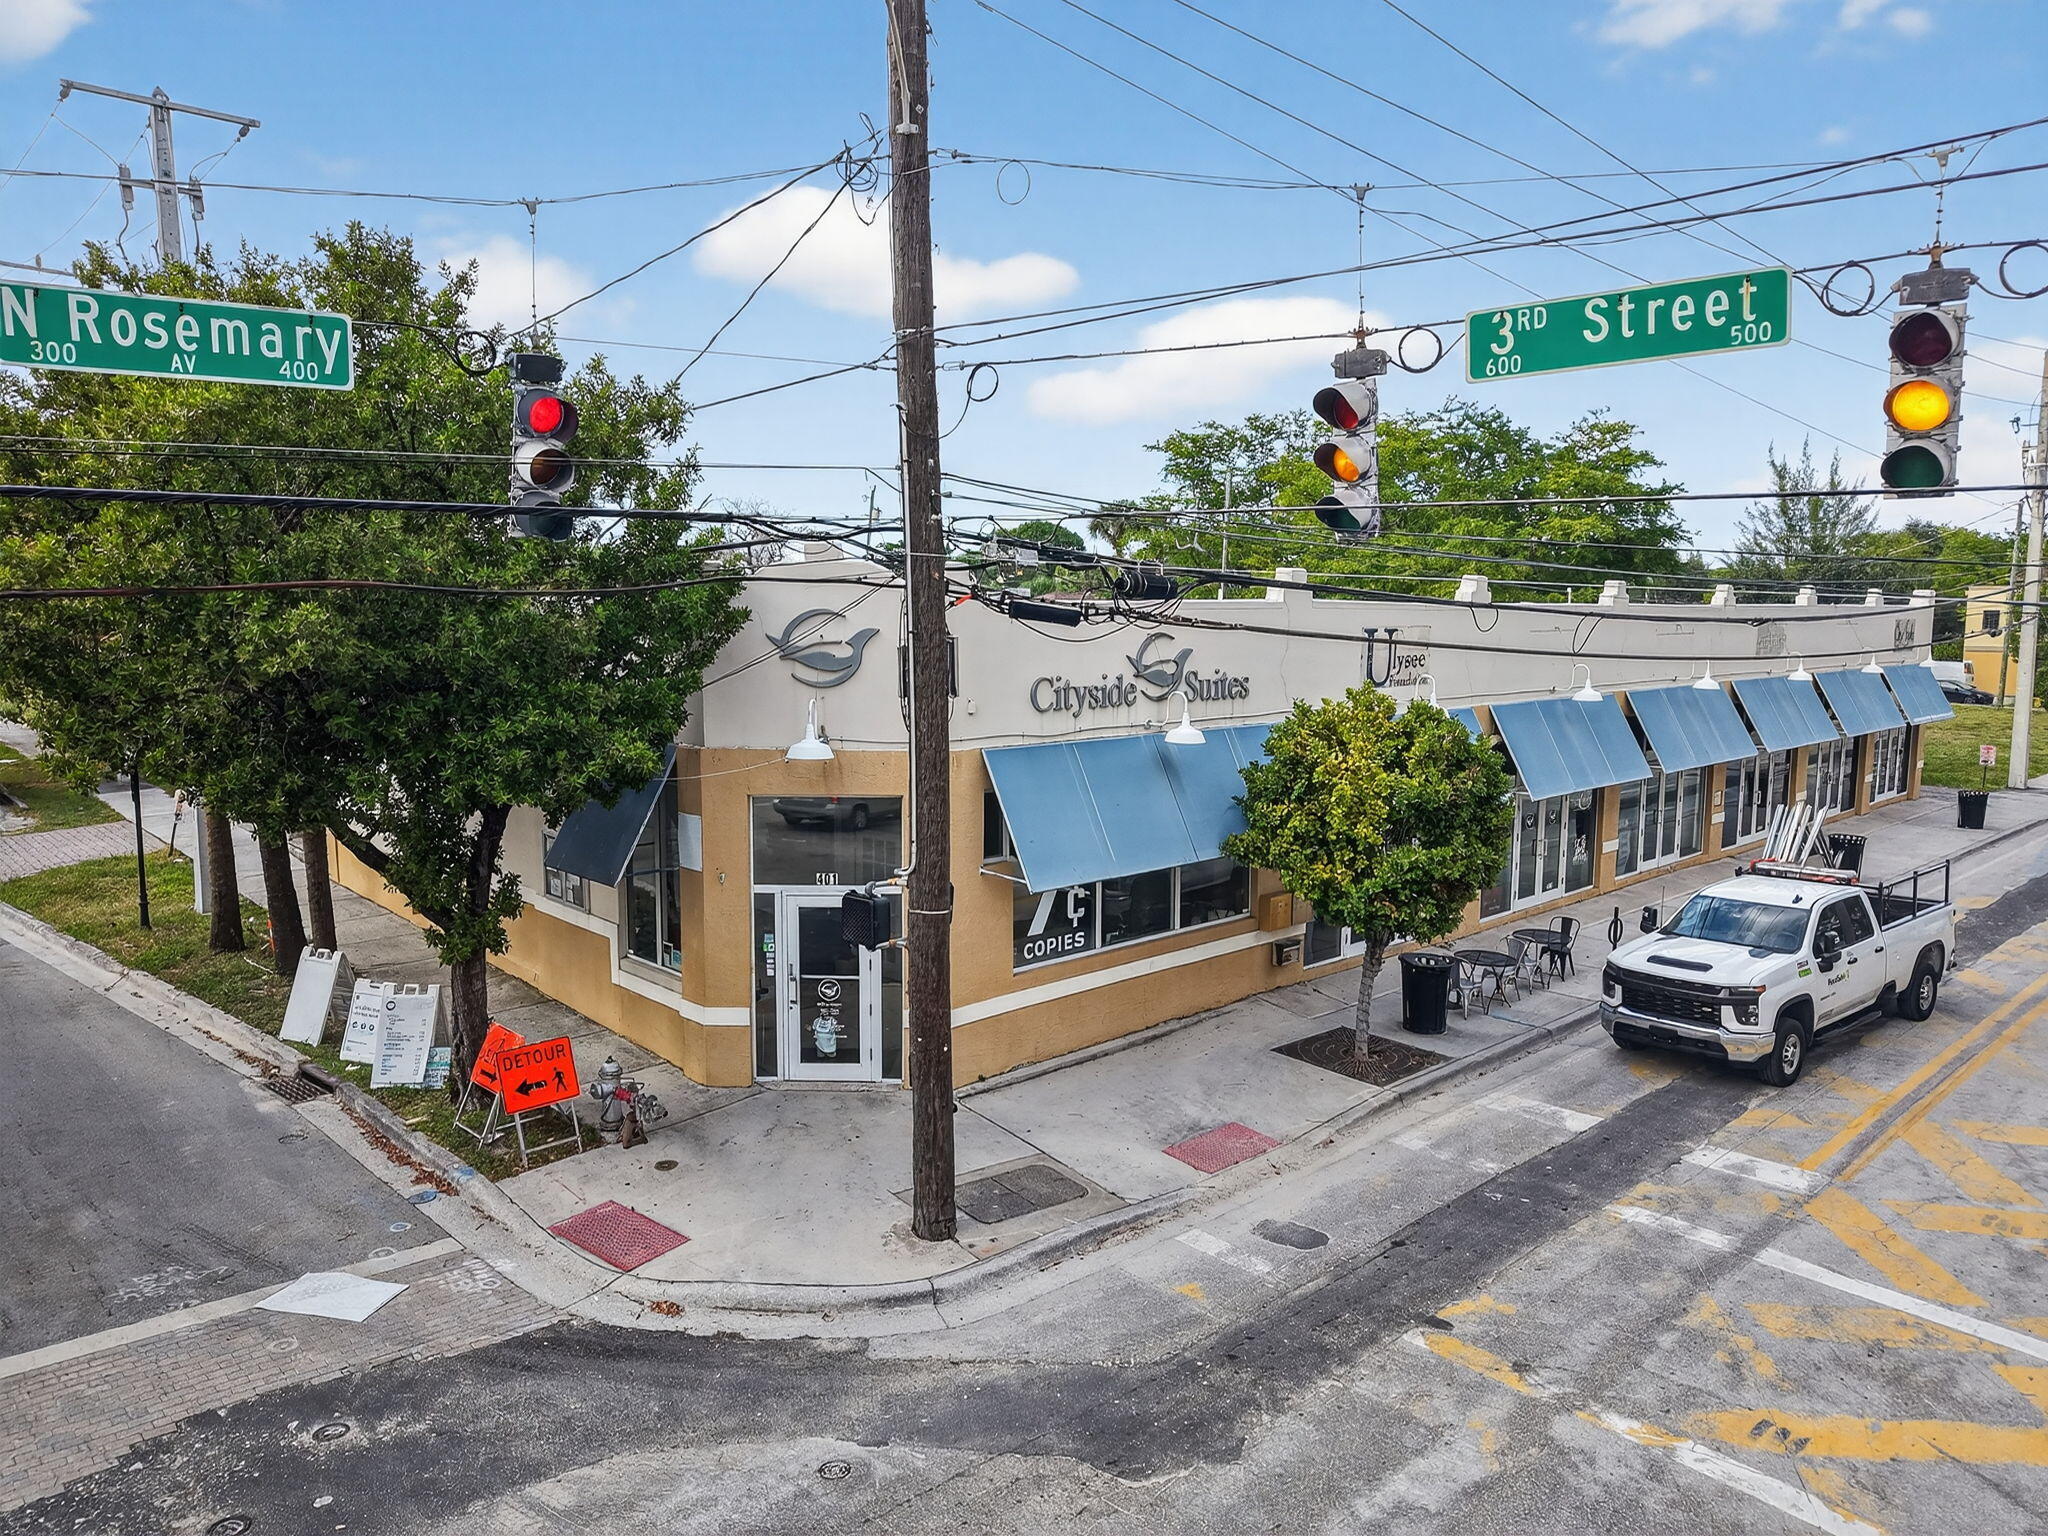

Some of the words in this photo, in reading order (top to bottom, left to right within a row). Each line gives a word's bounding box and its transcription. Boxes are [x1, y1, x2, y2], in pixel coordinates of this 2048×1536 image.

[1, 286, 38, 338] N
[68, 293, 341, 375] Rosemary
[1490, 307, 1547, 355] 3RD
[1583, 278, 1757, 343] Street
[1730, 321, 1772, 346] 500
[30, 340, 77, 364] 300
[170, 353, 196, 373] AV
[278, 360, 319, 381] 400
[1486, 355, 1522, 377] 600
[1030, 674, 1138, 718] Cityside
[1184, 669, 1250, 702] Suites
[816, 872, 838, 885] 401
[1023, 931, 1085, 960] COPIES
[503, 1044, 566, 1072] DETOUR
